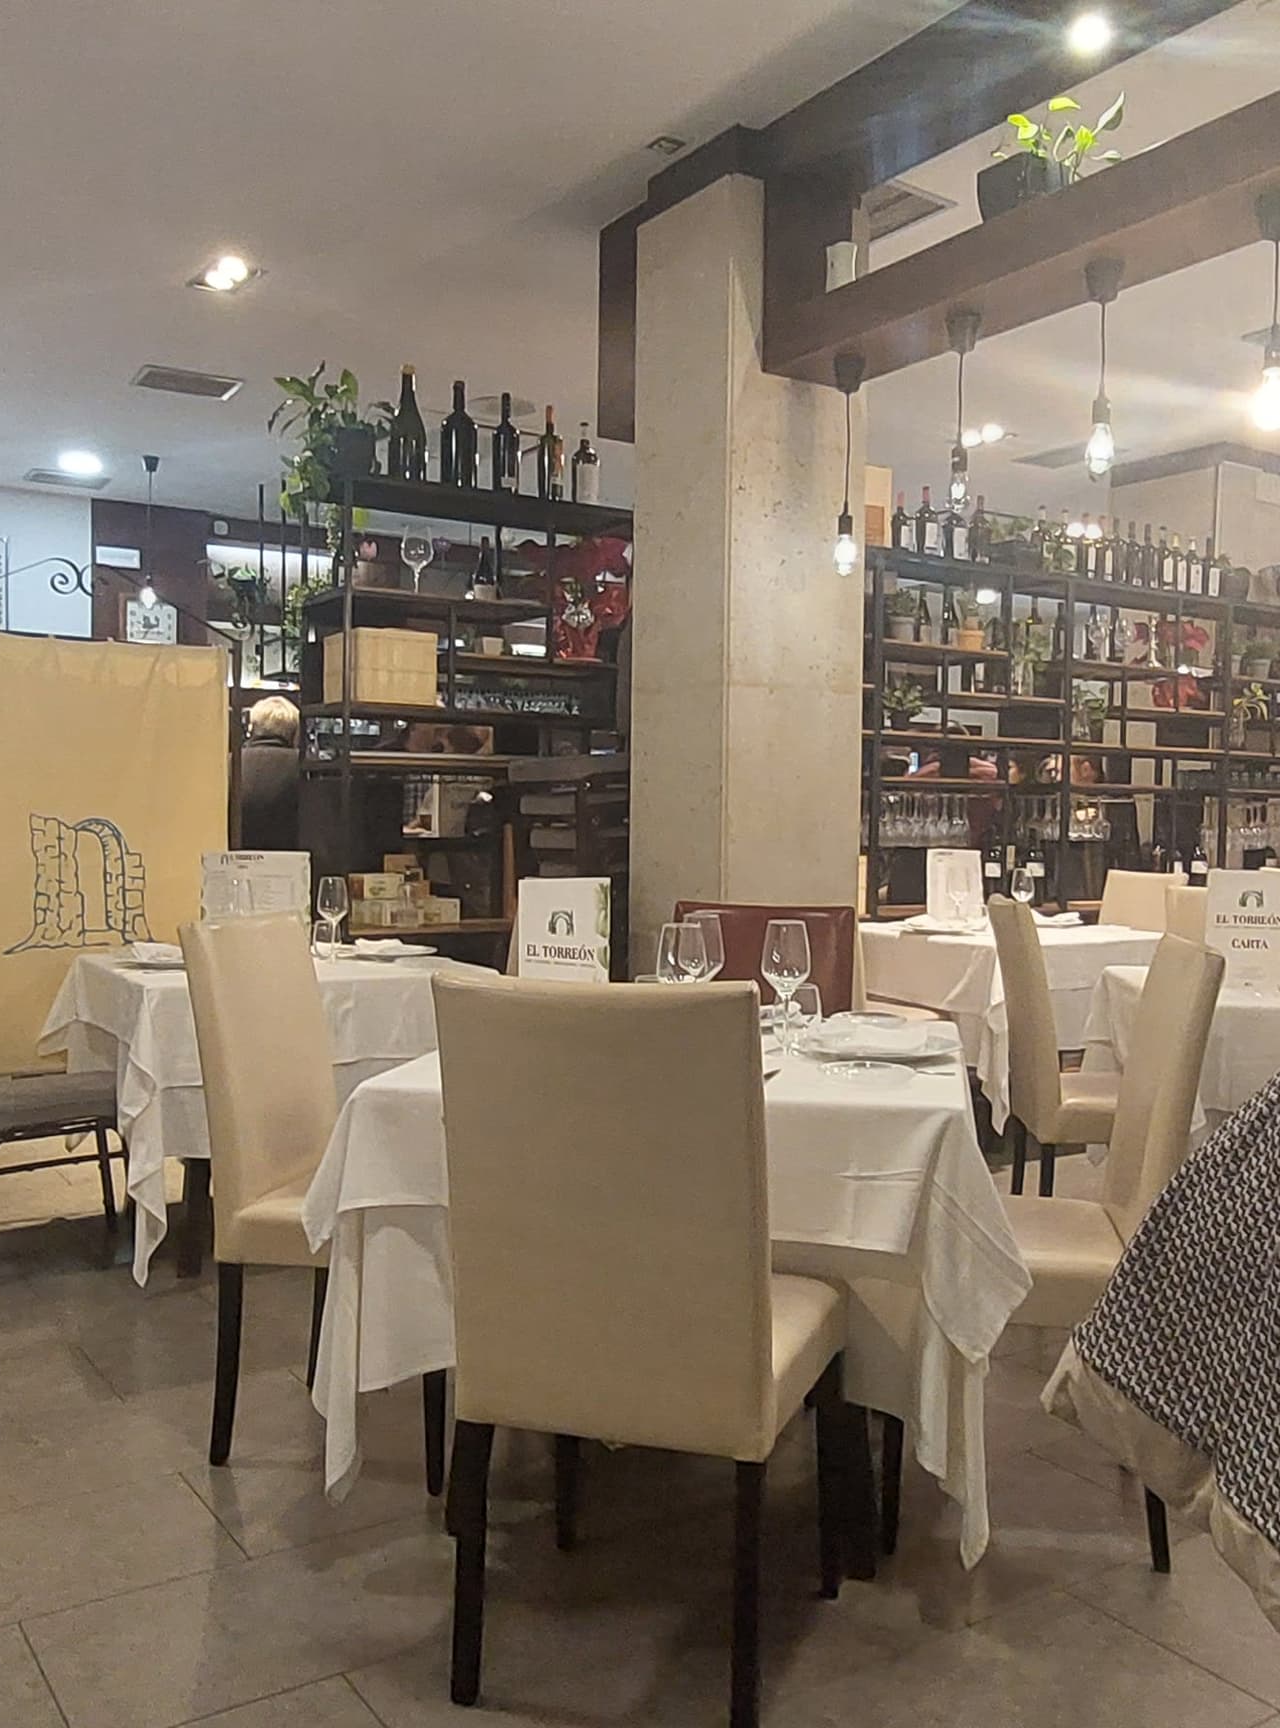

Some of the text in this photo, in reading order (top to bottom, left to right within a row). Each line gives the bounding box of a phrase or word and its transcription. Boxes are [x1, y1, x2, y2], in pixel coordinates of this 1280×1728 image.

[1216, 914, 1229, 924] EL
[1231, 938, 1269, 950] CARTA
[526, 944, 595, 961] EL TORREÓN
